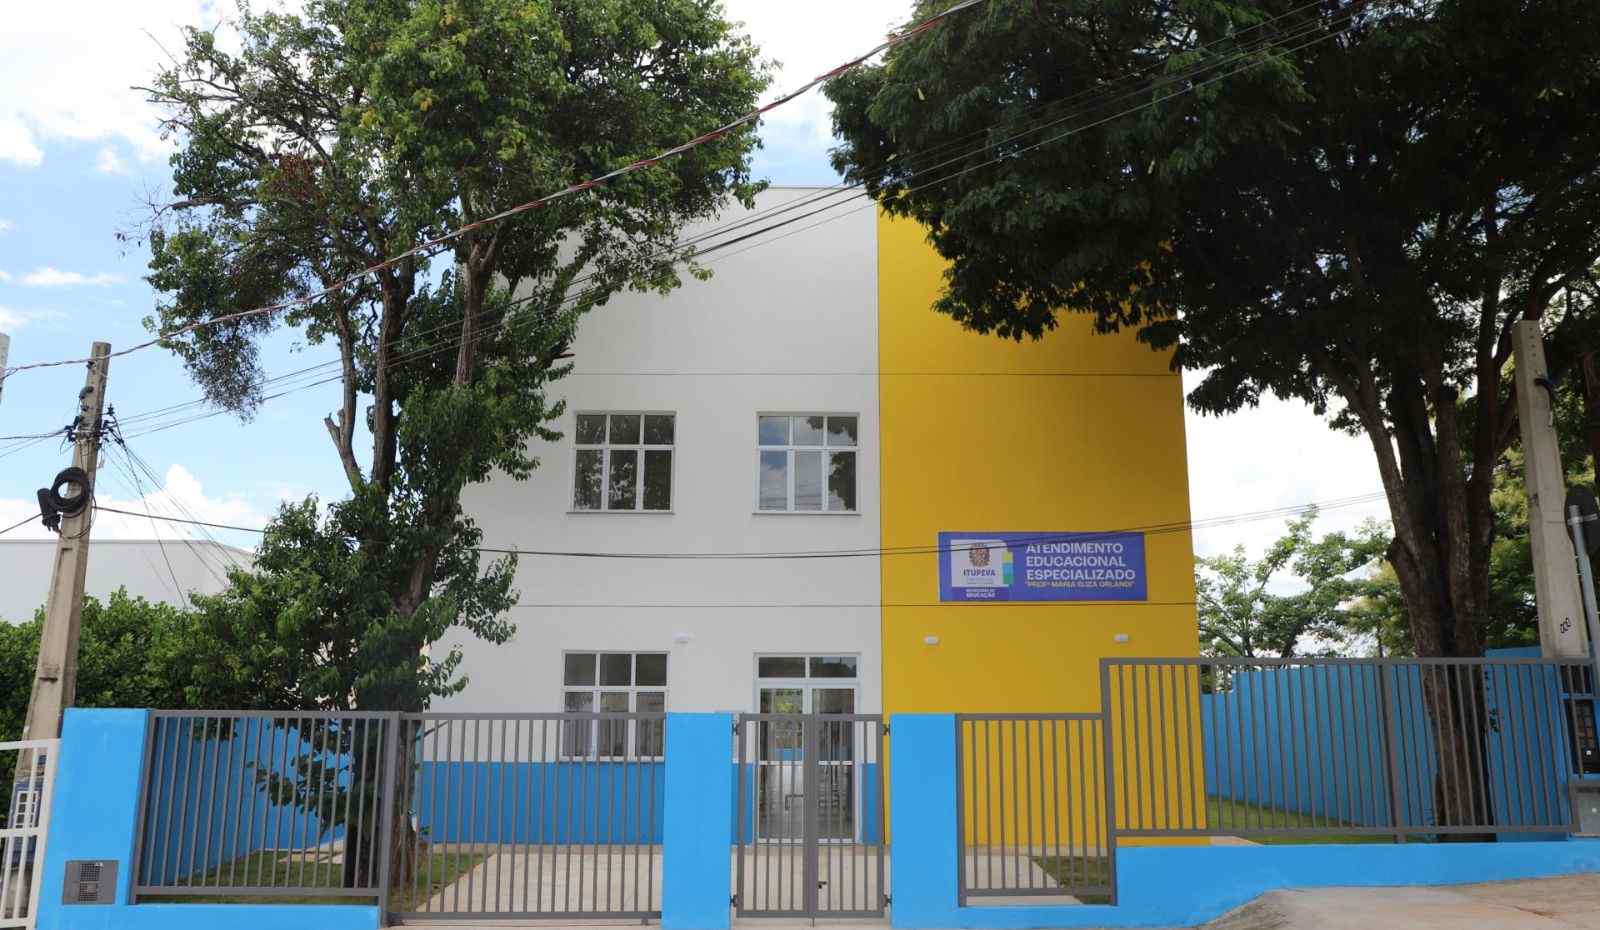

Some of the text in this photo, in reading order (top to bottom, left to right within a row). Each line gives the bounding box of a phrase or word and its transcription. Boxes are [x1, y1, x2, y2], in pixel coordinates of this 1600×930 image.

[1025, 543, 1124, 554] ATENDIMENTO
[1026, 556, 1127, 567] EDUCACIONAL
[1026, 569, 1136, 580] ESPECIALIZADO
